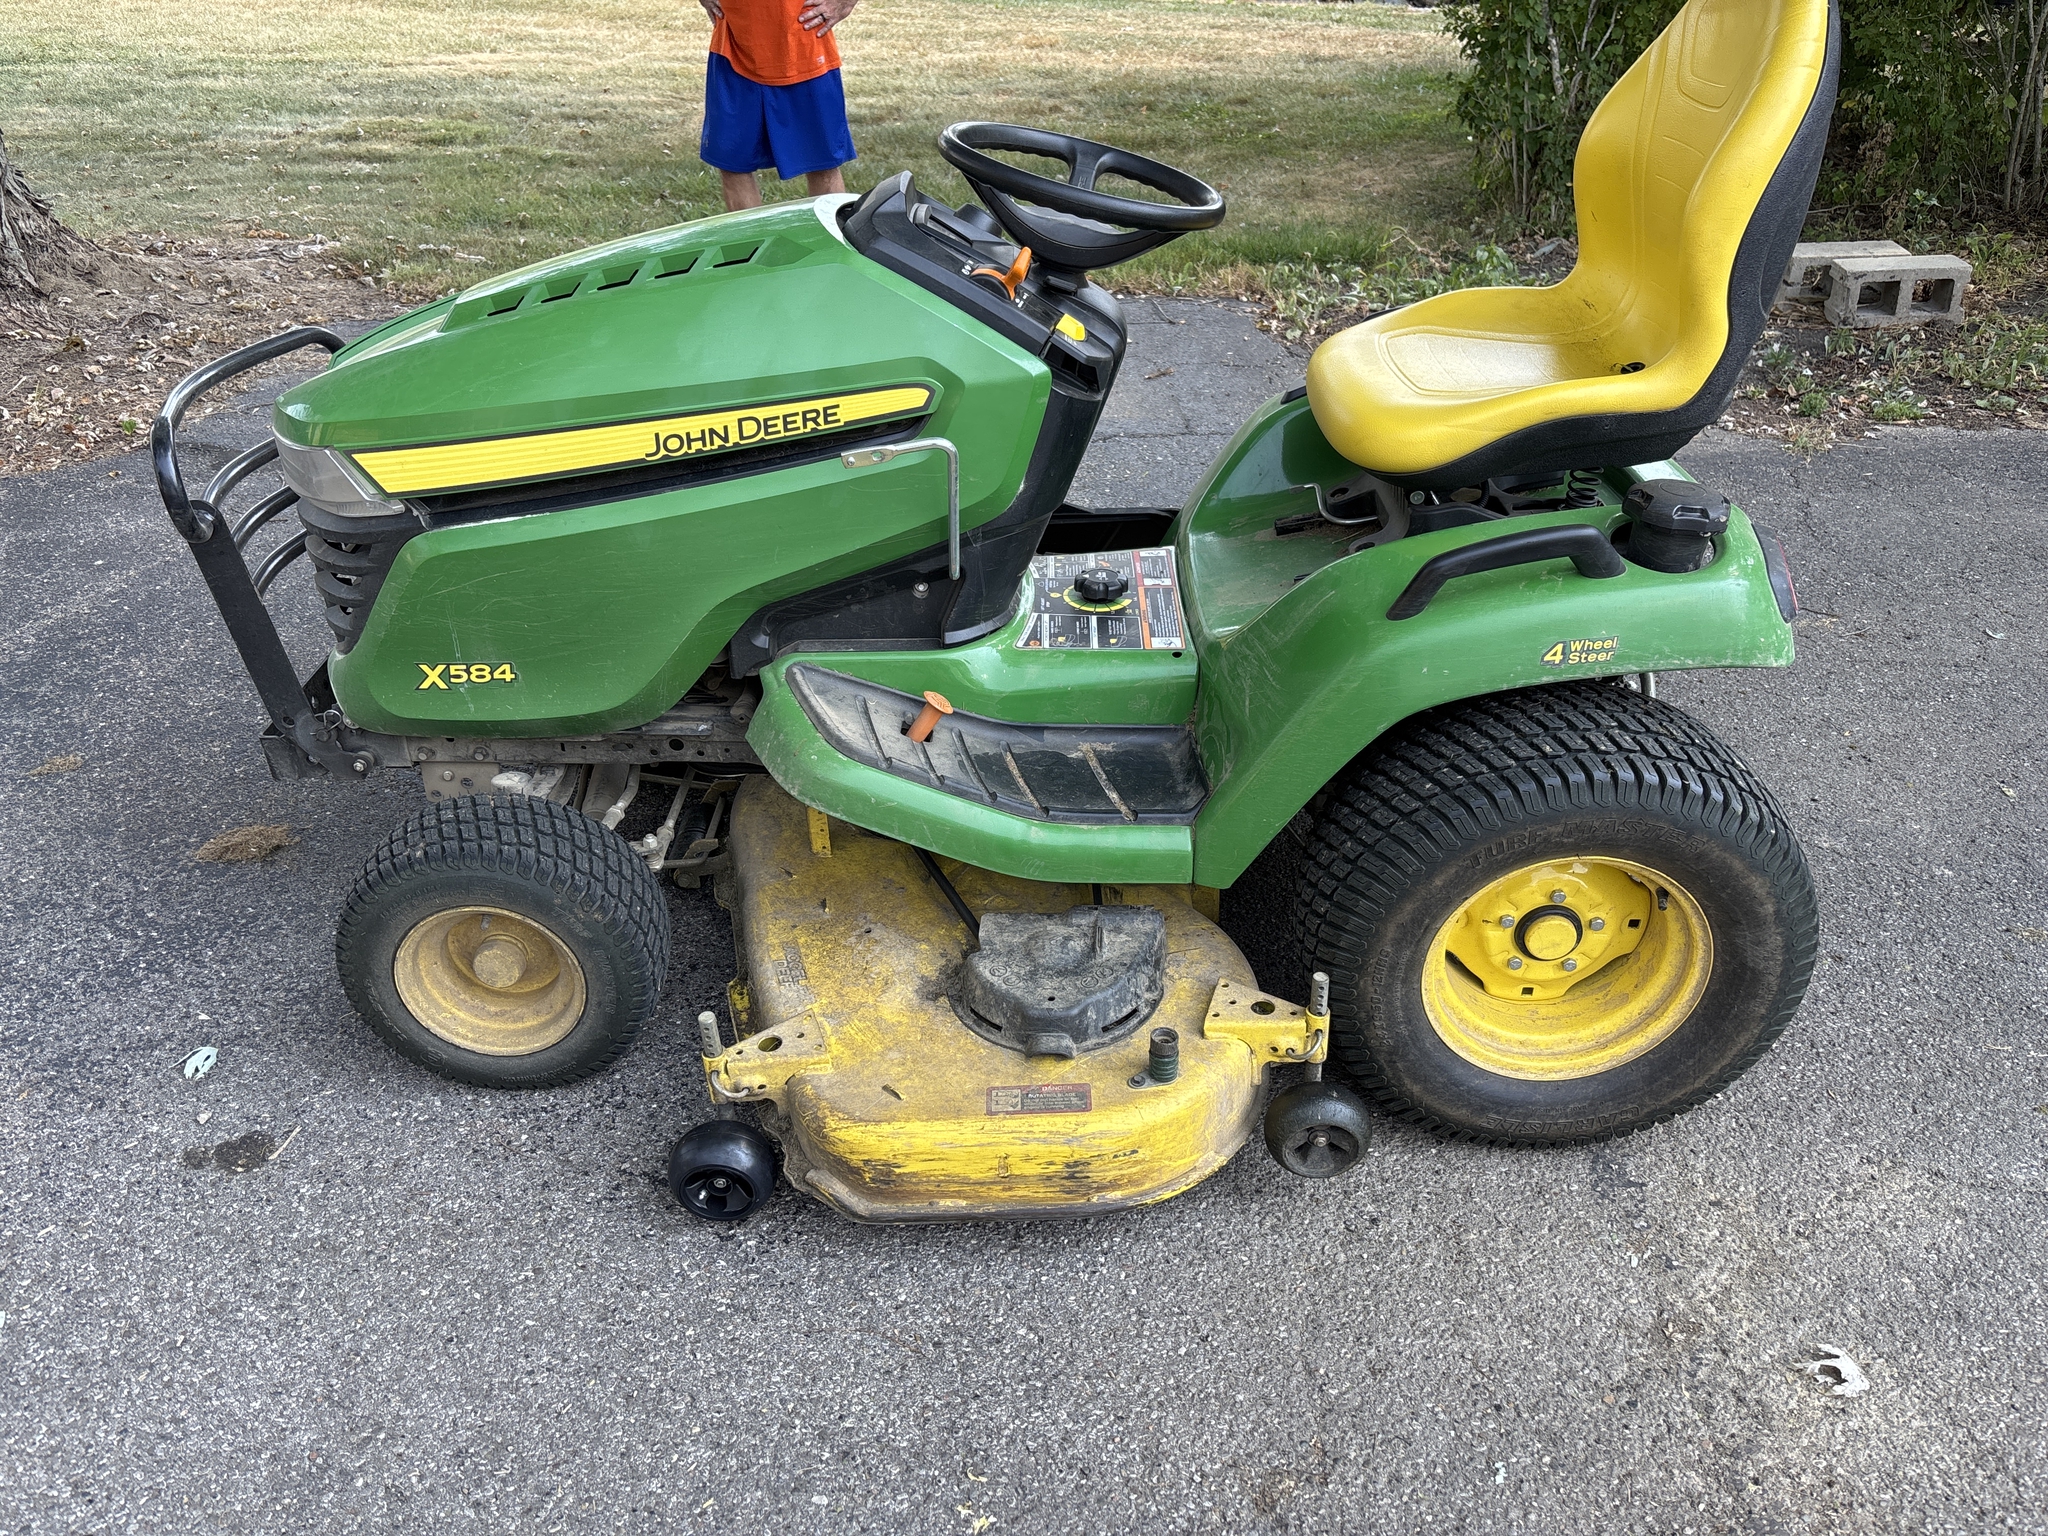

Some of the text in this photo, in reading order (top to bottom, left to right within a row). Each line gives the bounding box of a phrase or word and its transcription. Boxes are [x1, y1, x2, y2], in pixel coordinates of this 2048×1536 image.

[645, 404, 841, 458] JOHN DEERE
[1543, 636, 1618, 664] 4 Wheel
[1567, 651, 1614, 664] Steer
[417, 663, 516, 690] X584
[1463, 817, 1707, 869] TURF MASTER
[1479, 1105, 1641, 1134] CARLISLE
